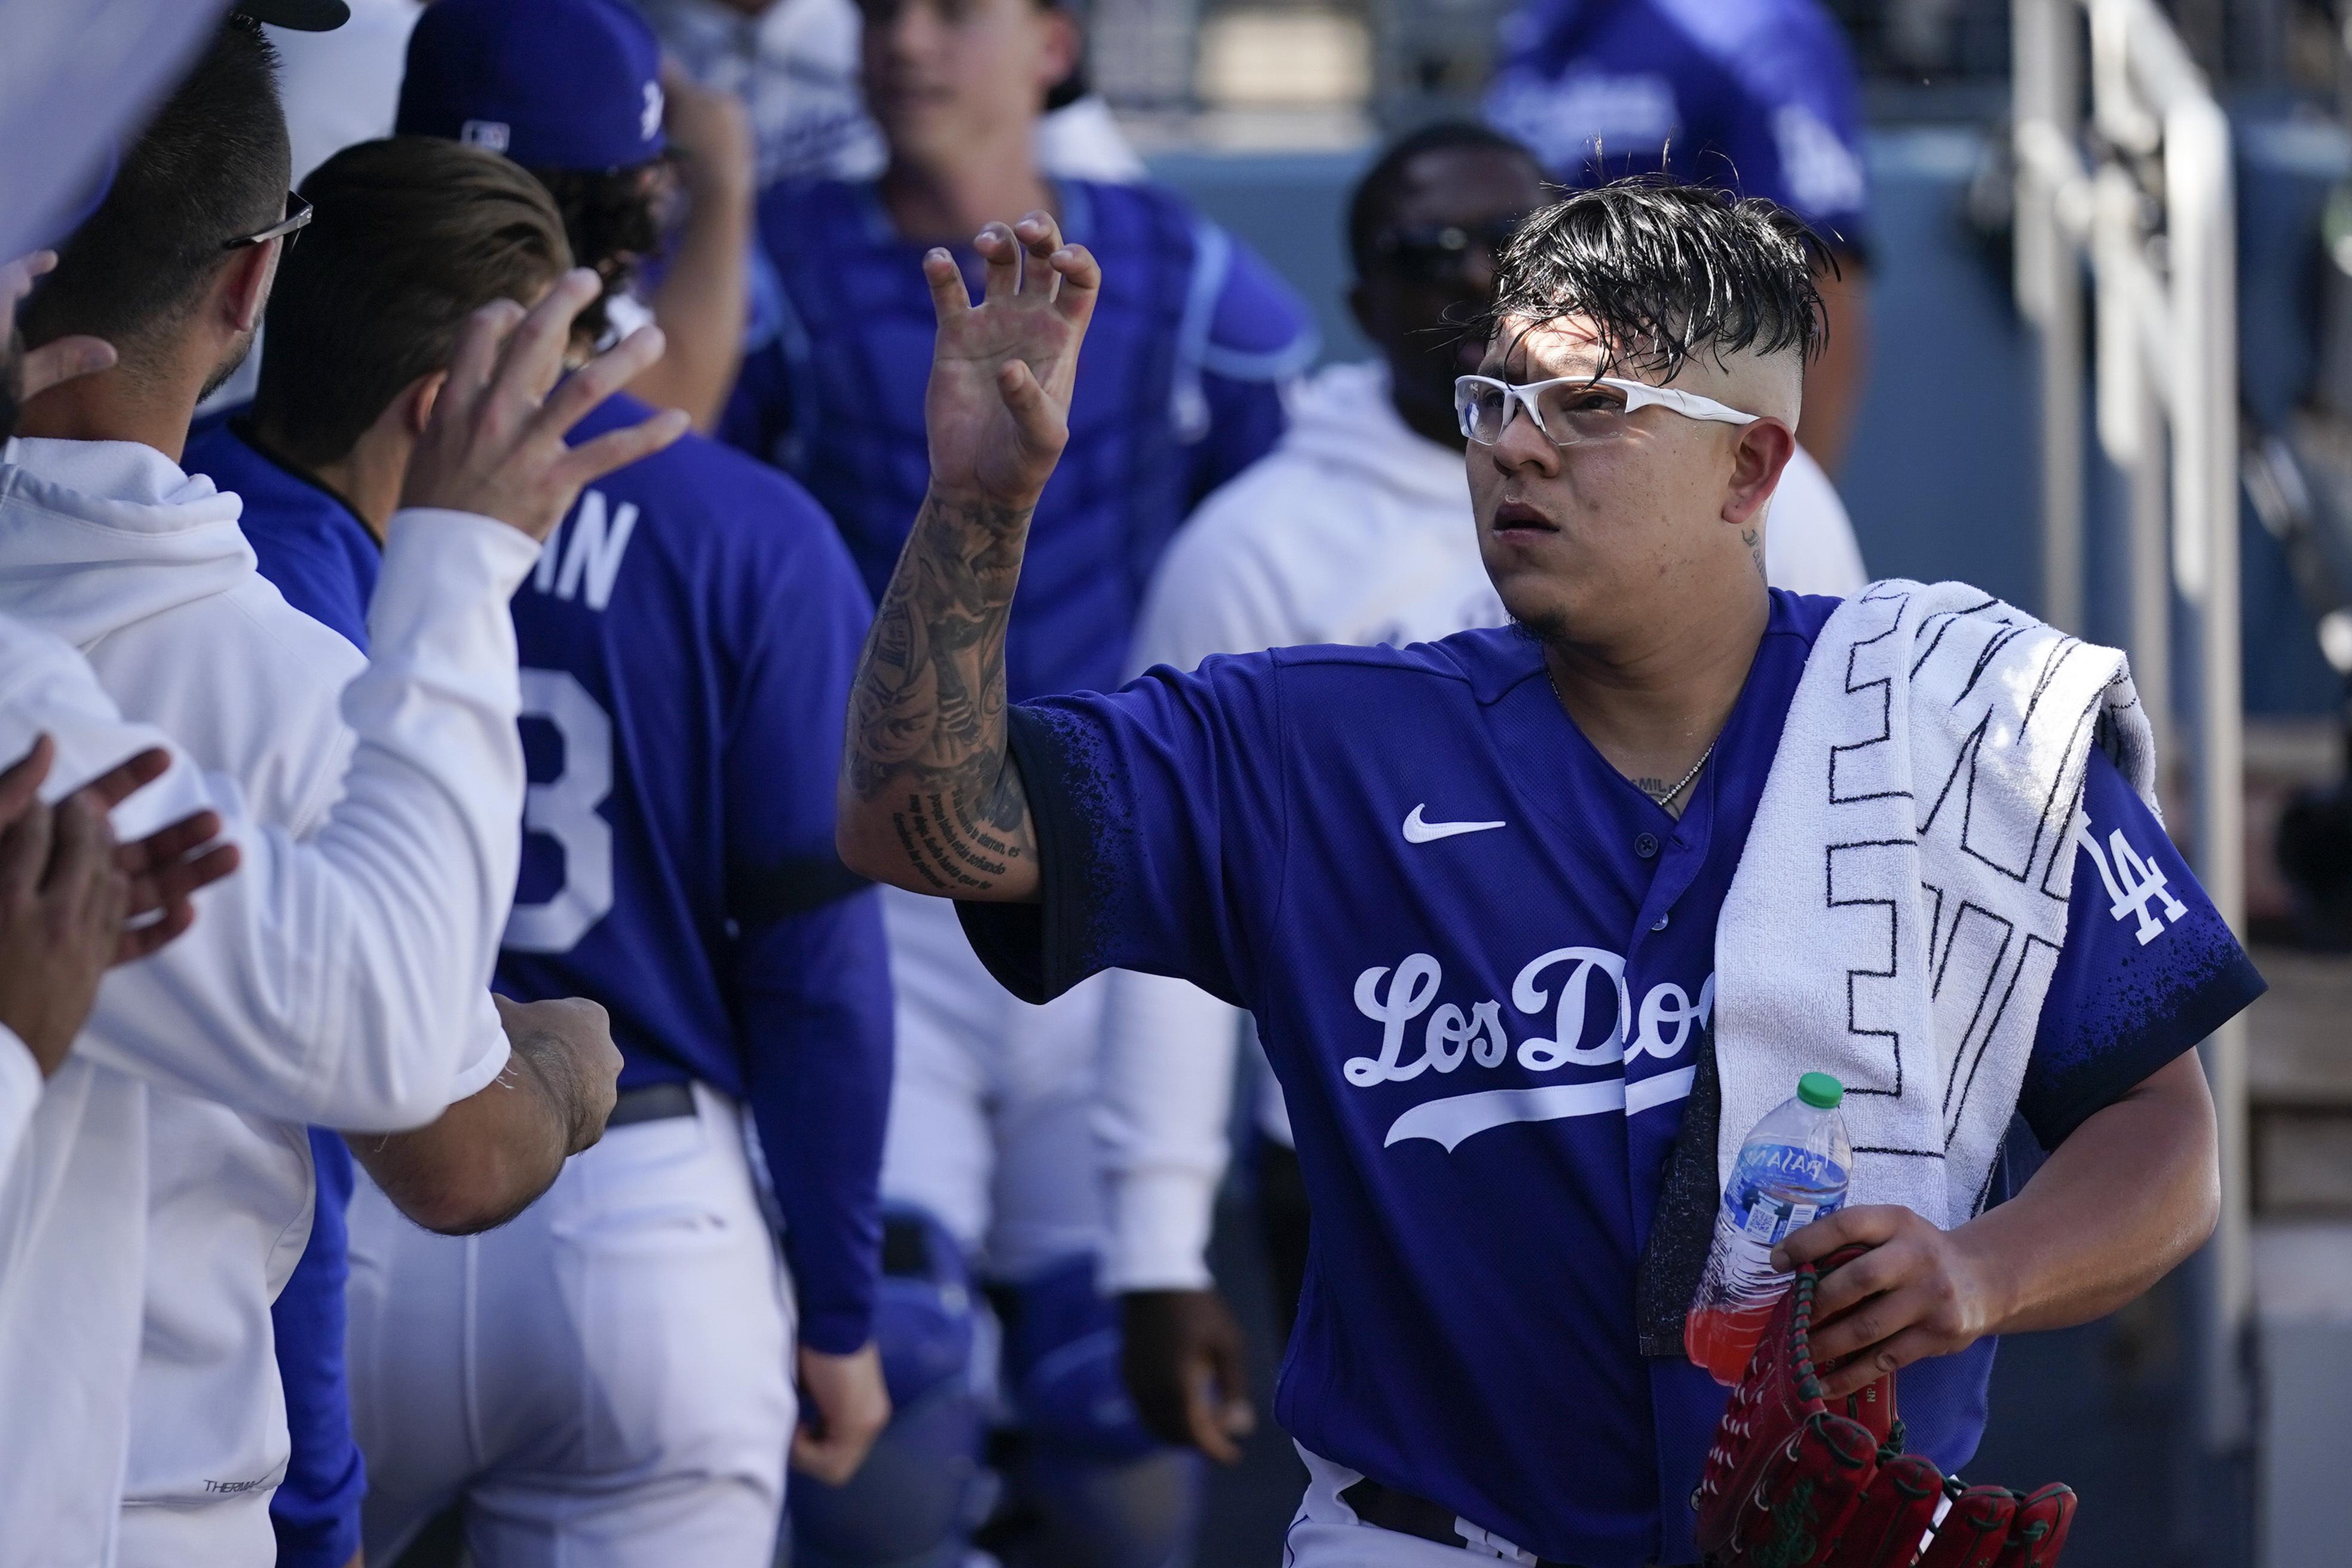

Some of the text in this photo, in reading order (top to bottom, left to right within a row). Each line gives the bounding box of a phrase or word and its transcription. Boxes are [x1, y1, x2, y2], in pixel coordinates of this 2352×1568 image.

[1007, 846, 1021, 858] es
[2075, 810, 2189, 947] LA
[1342, 952, 1508, 1088] Los
